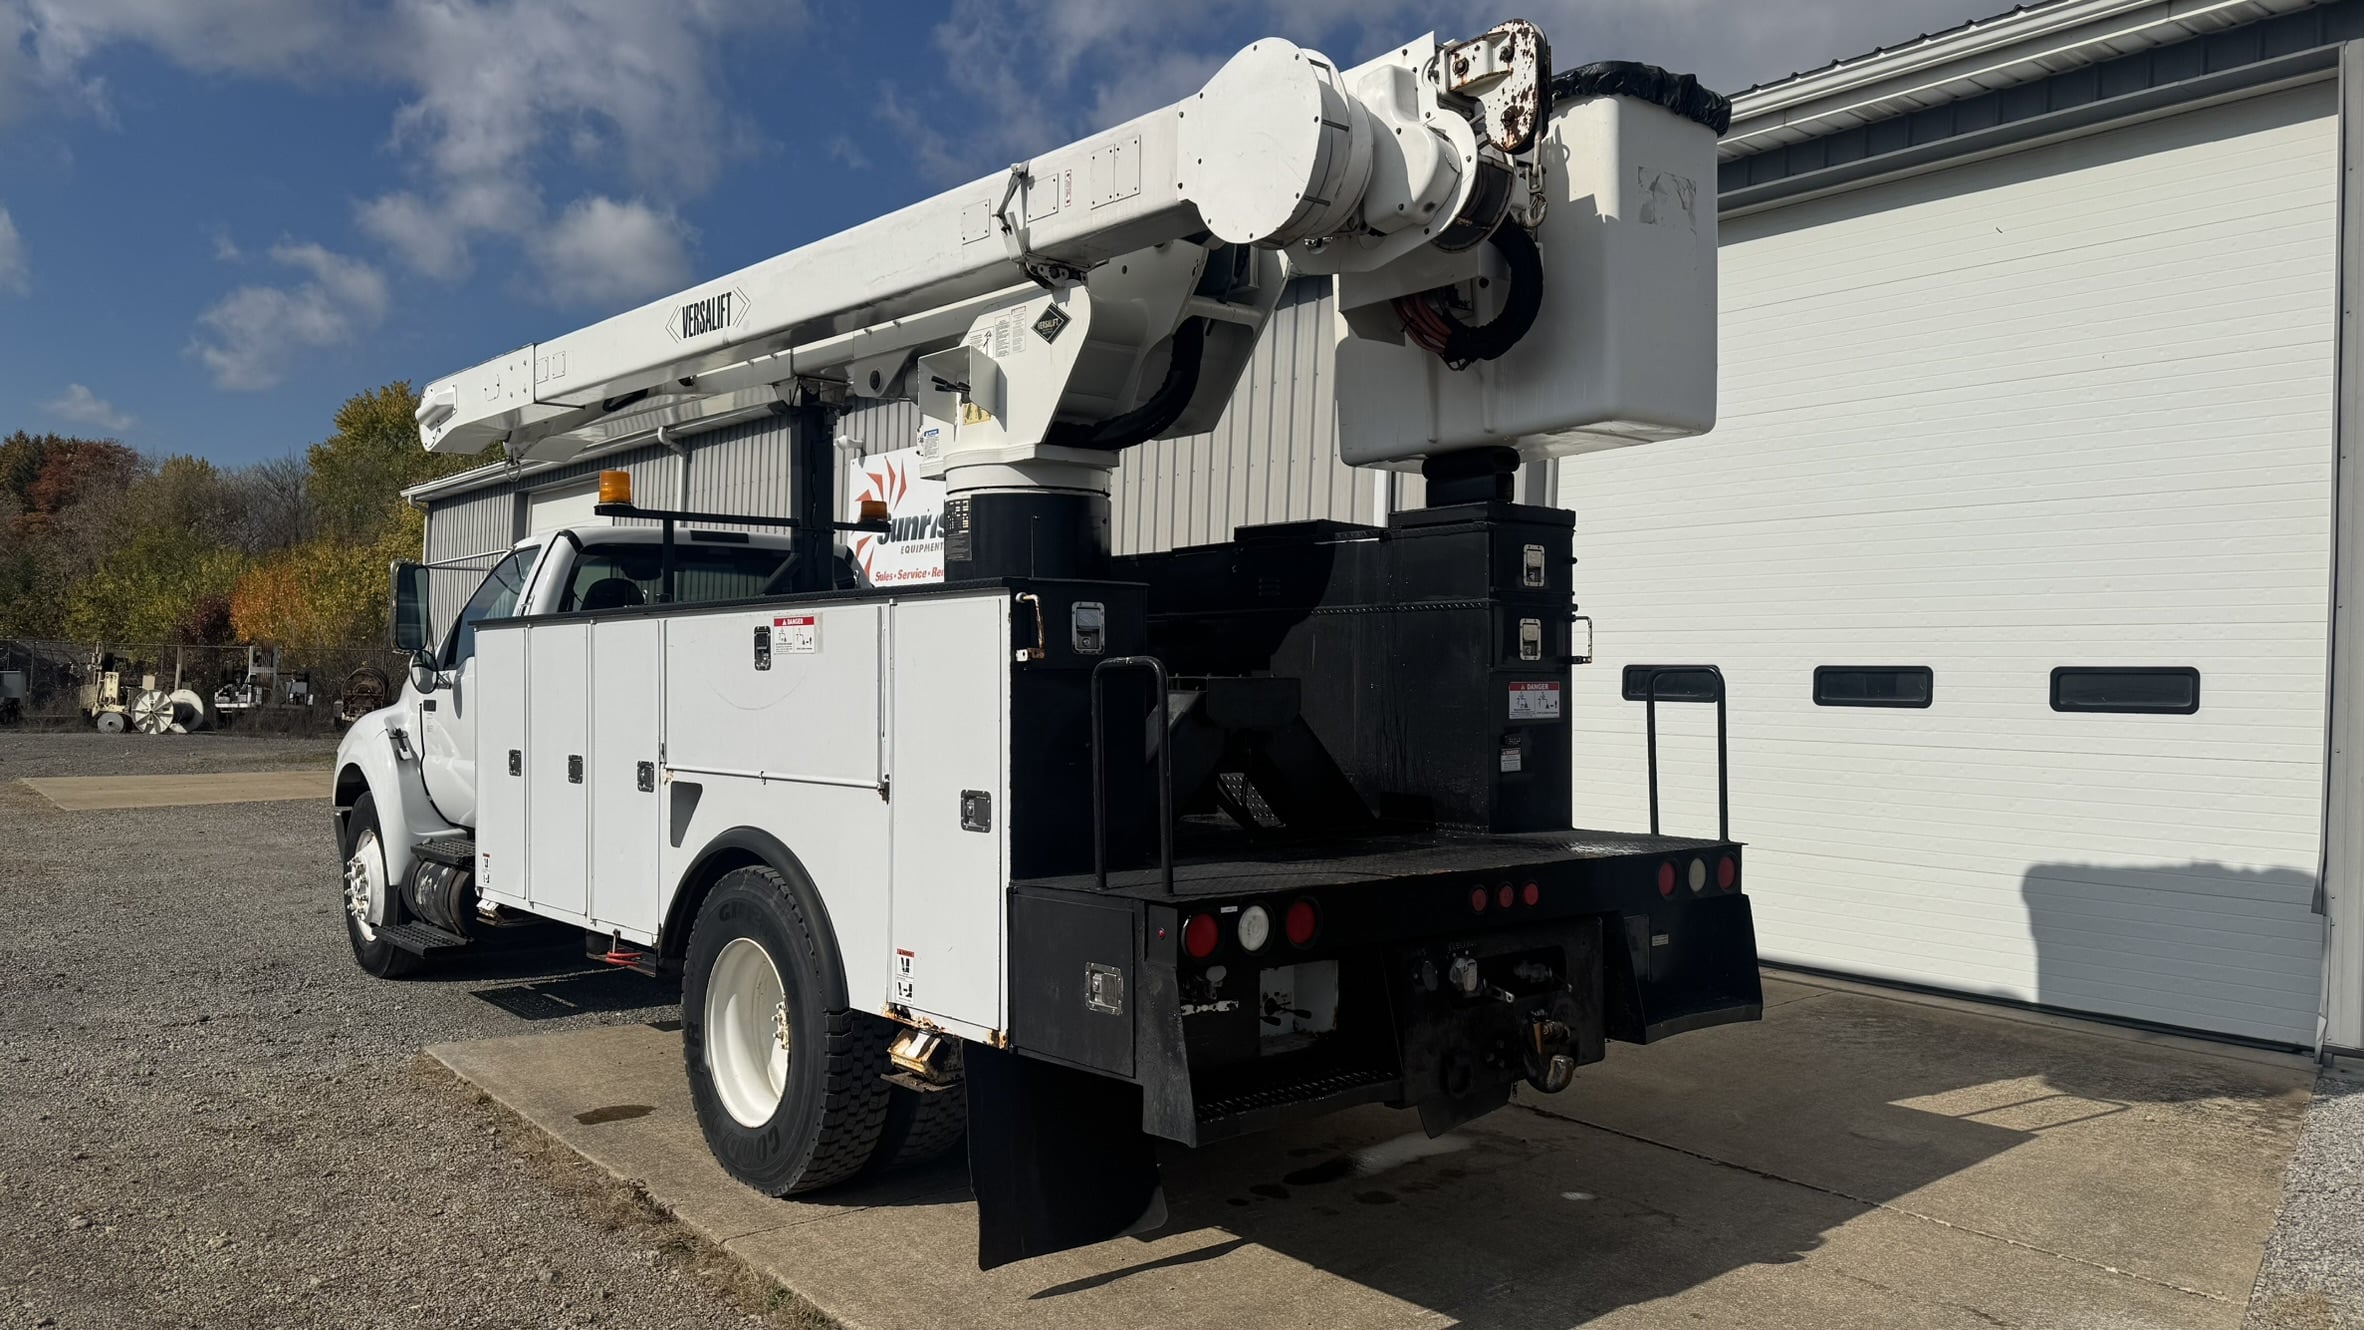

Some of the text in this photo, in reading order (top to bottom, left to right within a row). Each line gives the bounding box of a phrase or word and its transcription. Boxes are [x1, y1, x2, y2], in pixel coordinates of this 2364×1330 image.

[682, 291, 732, 339] VERSALIFT
[877, 512, 944, 545] Sunris
[901, 542, 944, 554] EQUIPMENT
[875, 571, 893, 581] Sales
[897, 567, 928, 580] Service
